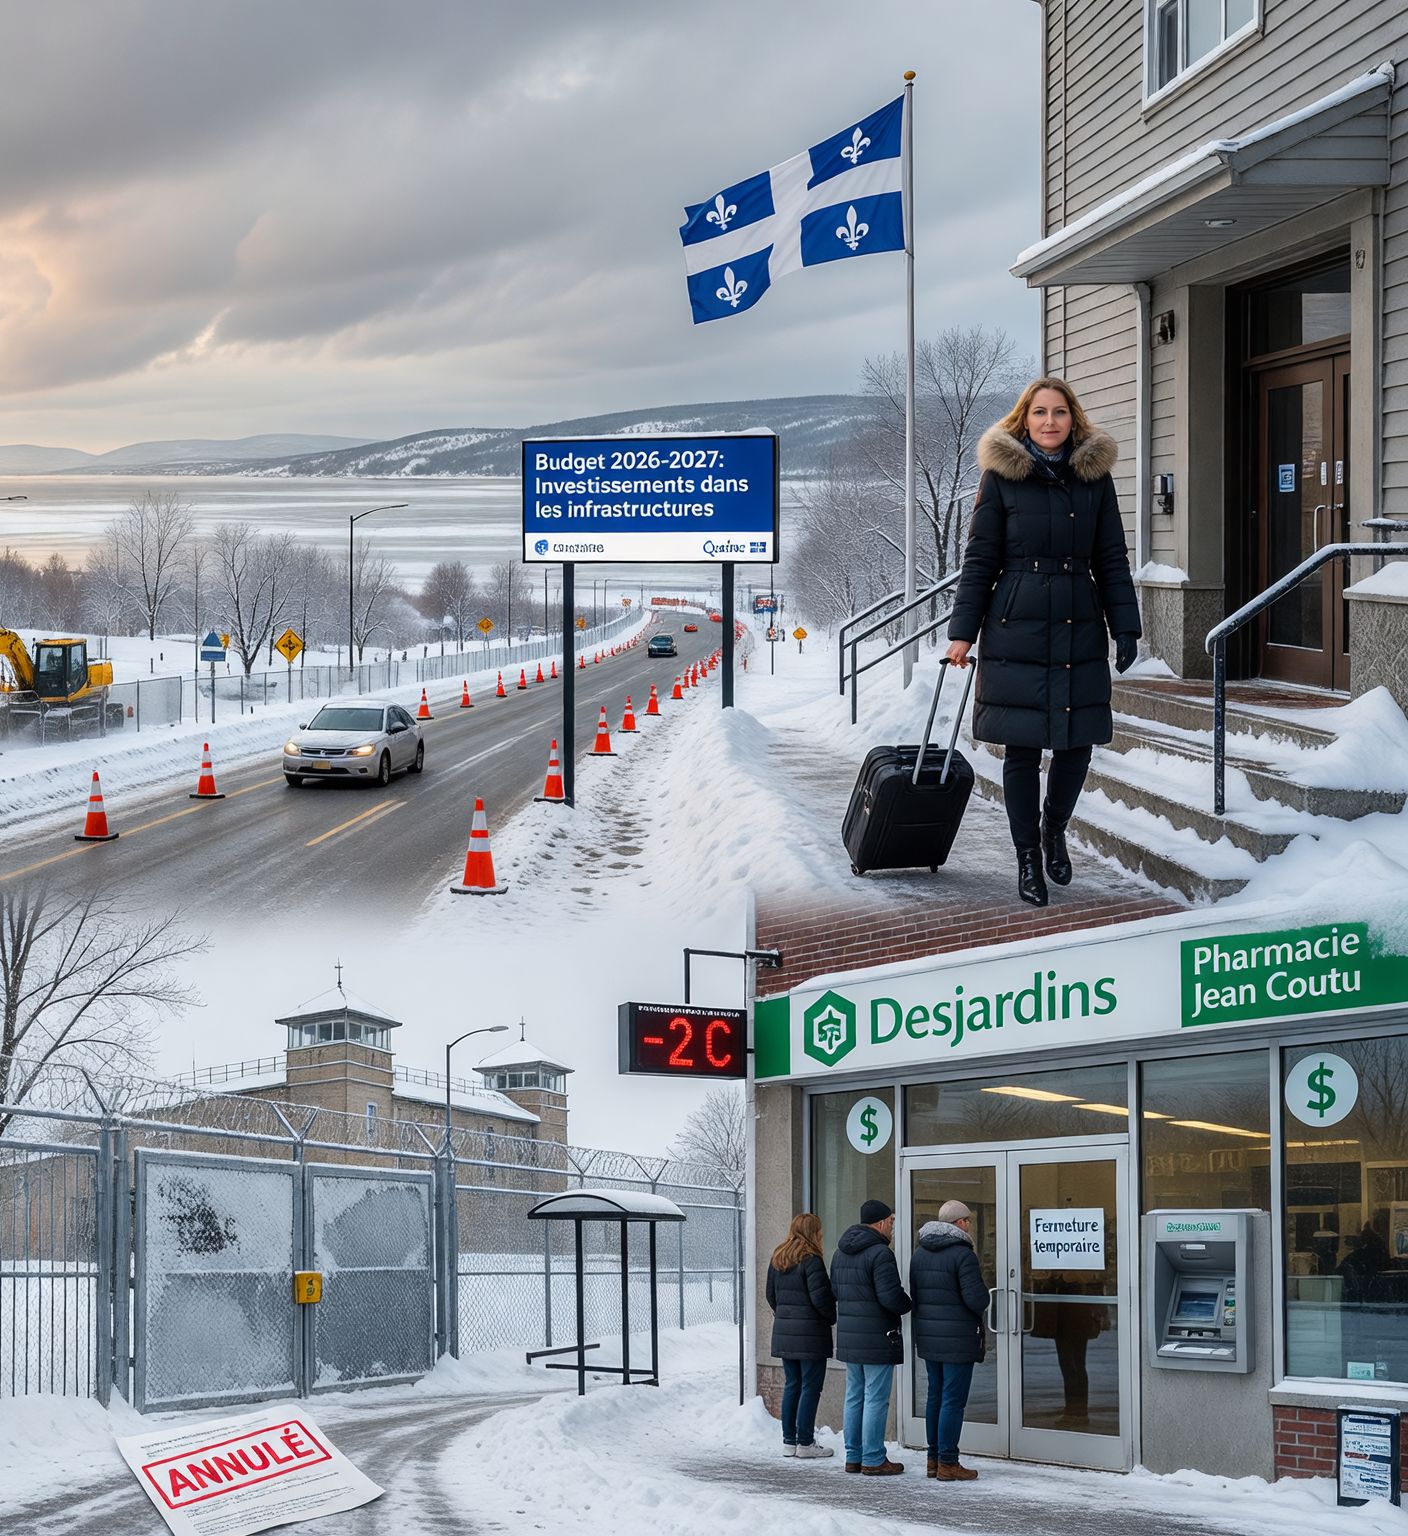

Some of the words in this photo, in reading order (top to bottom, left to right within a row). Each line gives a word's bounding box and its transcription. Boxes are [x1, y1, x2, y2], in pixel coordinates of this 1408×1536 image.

[535, 452, 606, 475] Budget
[610, 450, 725, 470] 2026-2027:
[535, 476, 695, 495] Investissements
[700, 475, 749, 493] dans
[535, 500, 562, 519] les
[568, 499, 714, 518] infrastructures
[1193, 927, 1361, 976] Pharmacie
[869, 970, 1119, 1050] Desjardins
[1191, 980, 1256, 1018] Jean
[1266, 967, 1361, 1001] Coutu
[643, 1017, 694, 1067] -2
[705, 1019, 732, 1068] C
[168, 1427, 315, 1498] ANNULÉ
